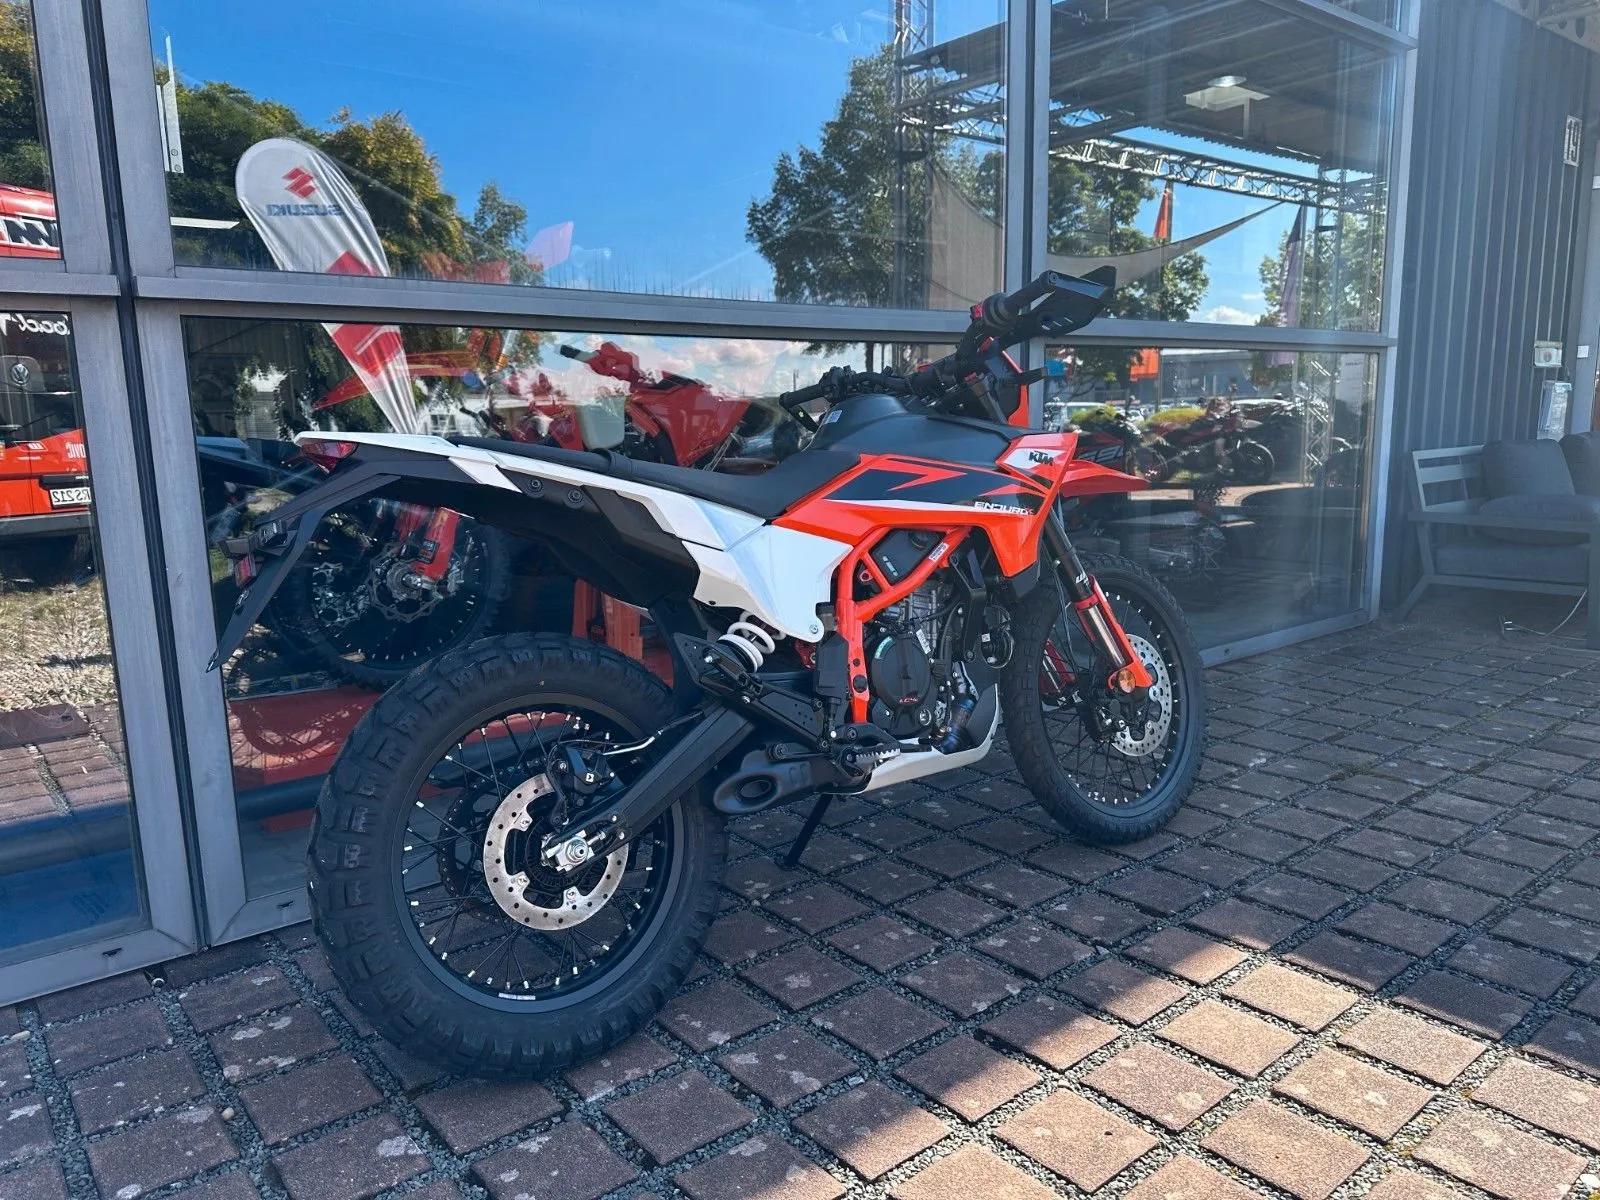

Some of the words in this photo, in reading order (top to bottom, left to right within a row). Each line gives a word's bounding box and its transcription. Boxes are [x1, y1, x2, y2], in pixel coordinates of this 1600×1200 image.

[1567, 119, 1580, 162] 19
[1028, 450, 1054, 466] KTM
[974, 501, 1028, 515] ENDURO
